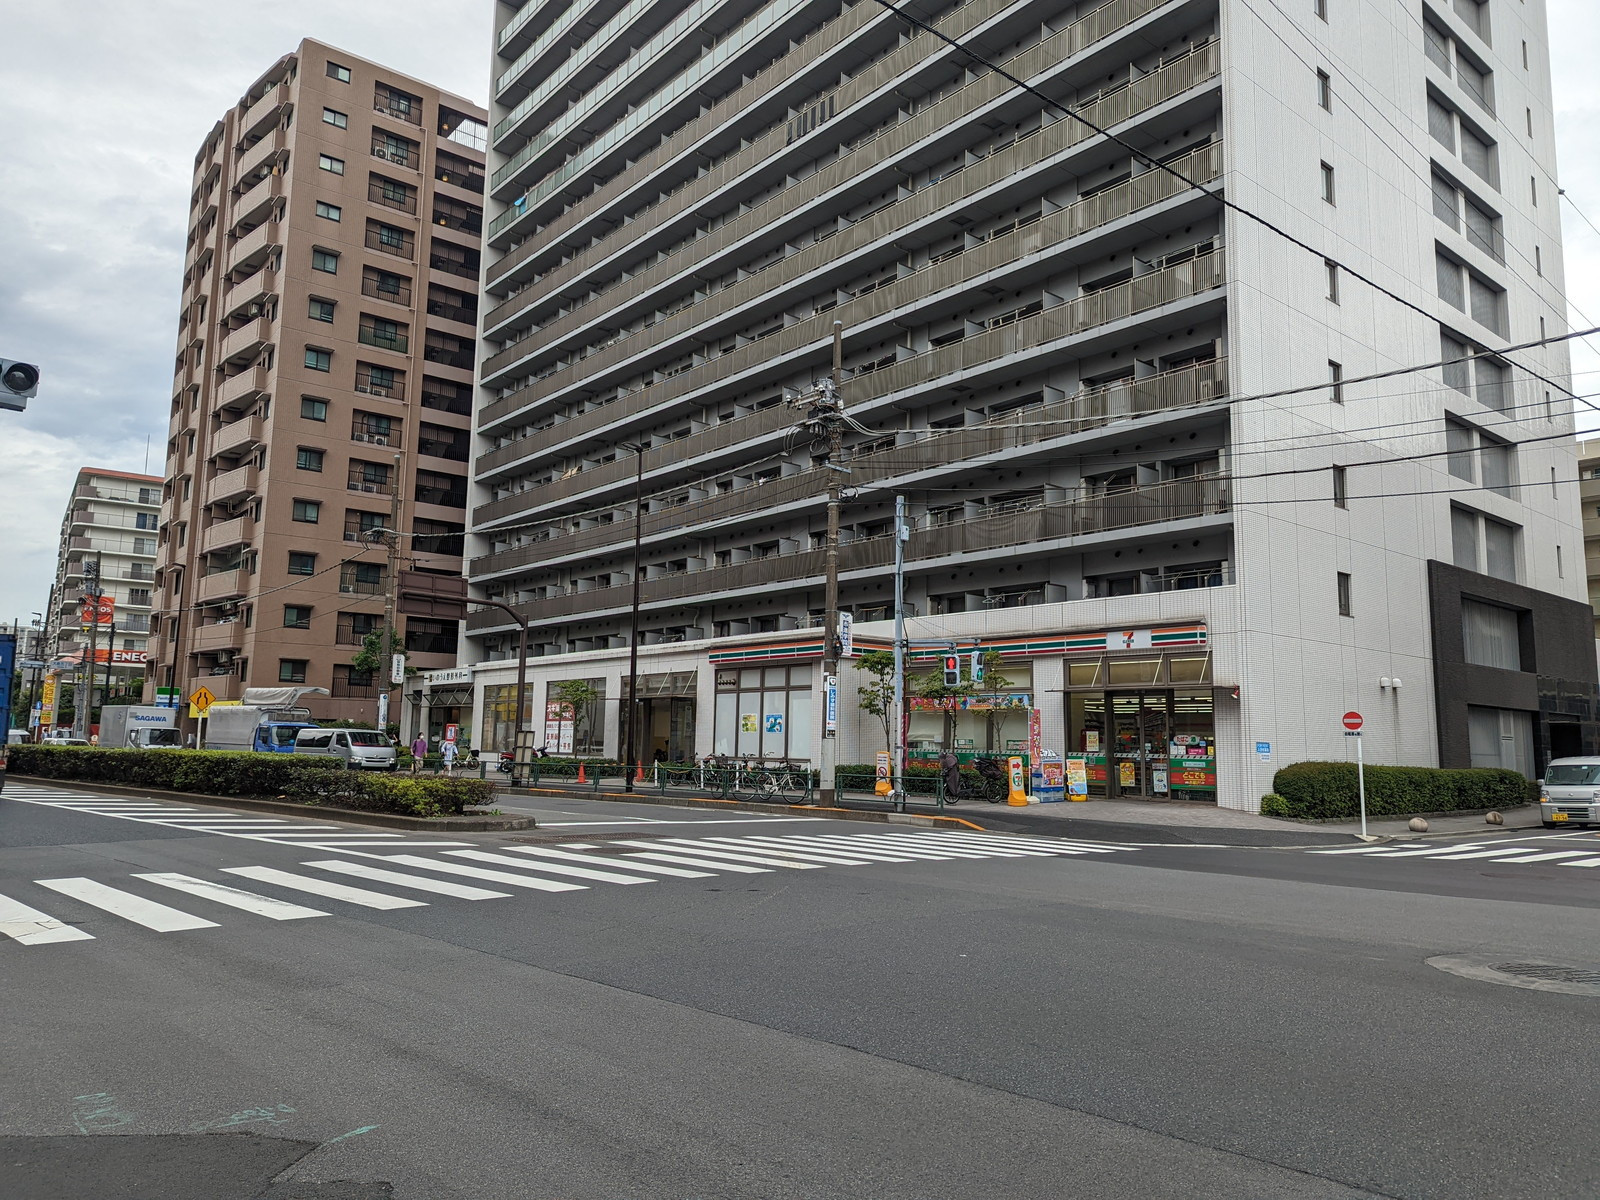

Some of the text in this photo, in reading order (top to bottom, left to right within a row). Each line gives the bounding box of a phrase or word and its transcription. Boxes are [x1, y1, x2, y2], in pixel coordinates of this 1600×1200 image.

[135, 715, 167, 723] SAGAWA
[1182, 771, 1206, 779] どこでも
